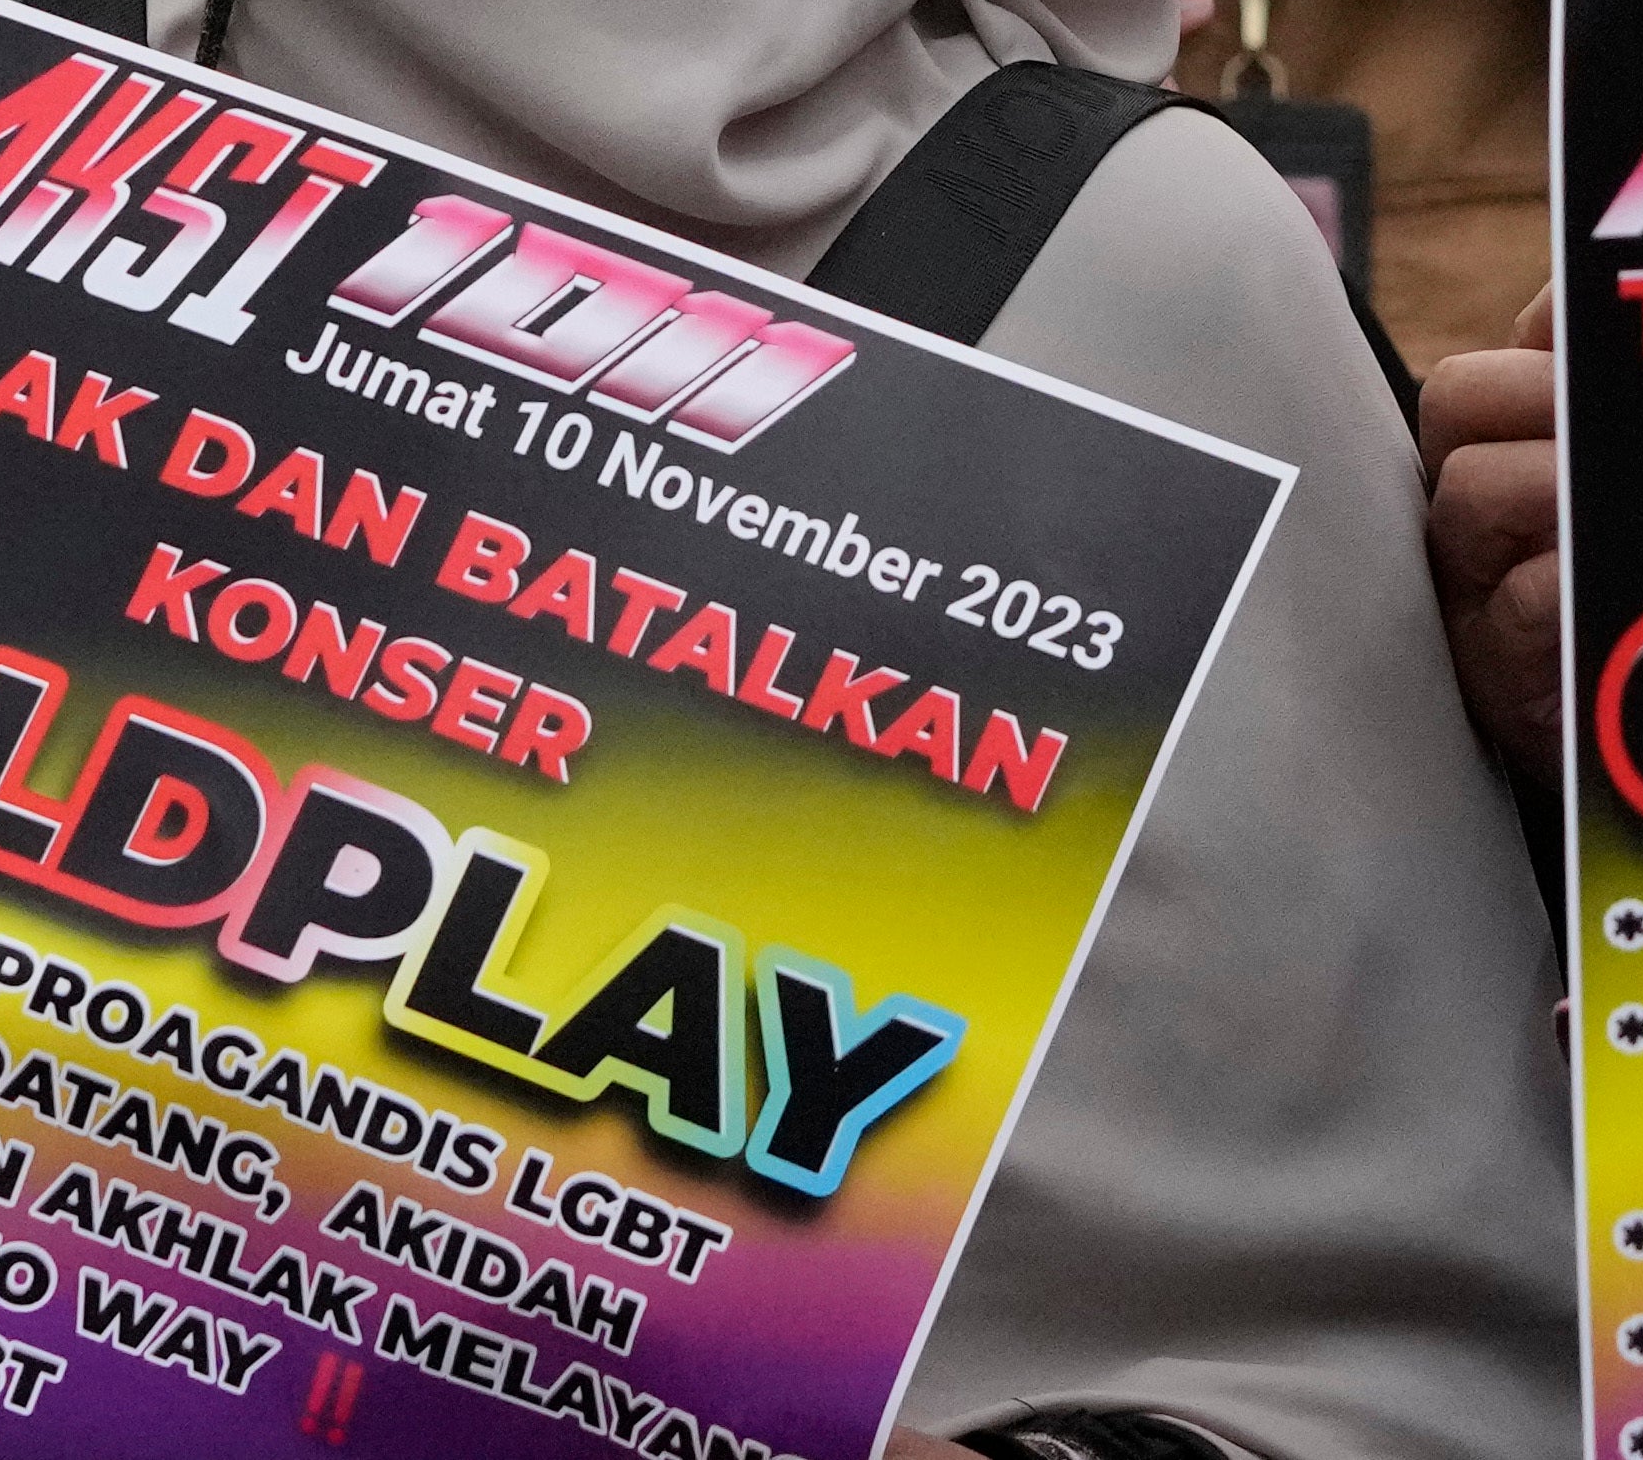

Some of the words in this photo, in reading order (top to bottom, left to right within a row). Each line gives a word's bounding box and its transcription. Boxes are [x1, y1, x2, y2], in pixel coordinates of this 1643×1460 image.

[284, 321, 497, 442] Jumat
[513, 398, 592, 474] 10
[597, 429, 945, 603] November
[944, 563, 1126, 674] 2023
[123, 541, 592, 783] KONSER
[158, 408, 427, 570] DAN
[436, 509, 1070, 817] BATALKAN
[31, 1162, 379, 1344] AKHLAK
[323, 1180, 646, 1356] AKIDAH
[507, 1150, 732, 1283] LGBT
[76, 1266, 282, 1396] WAY
